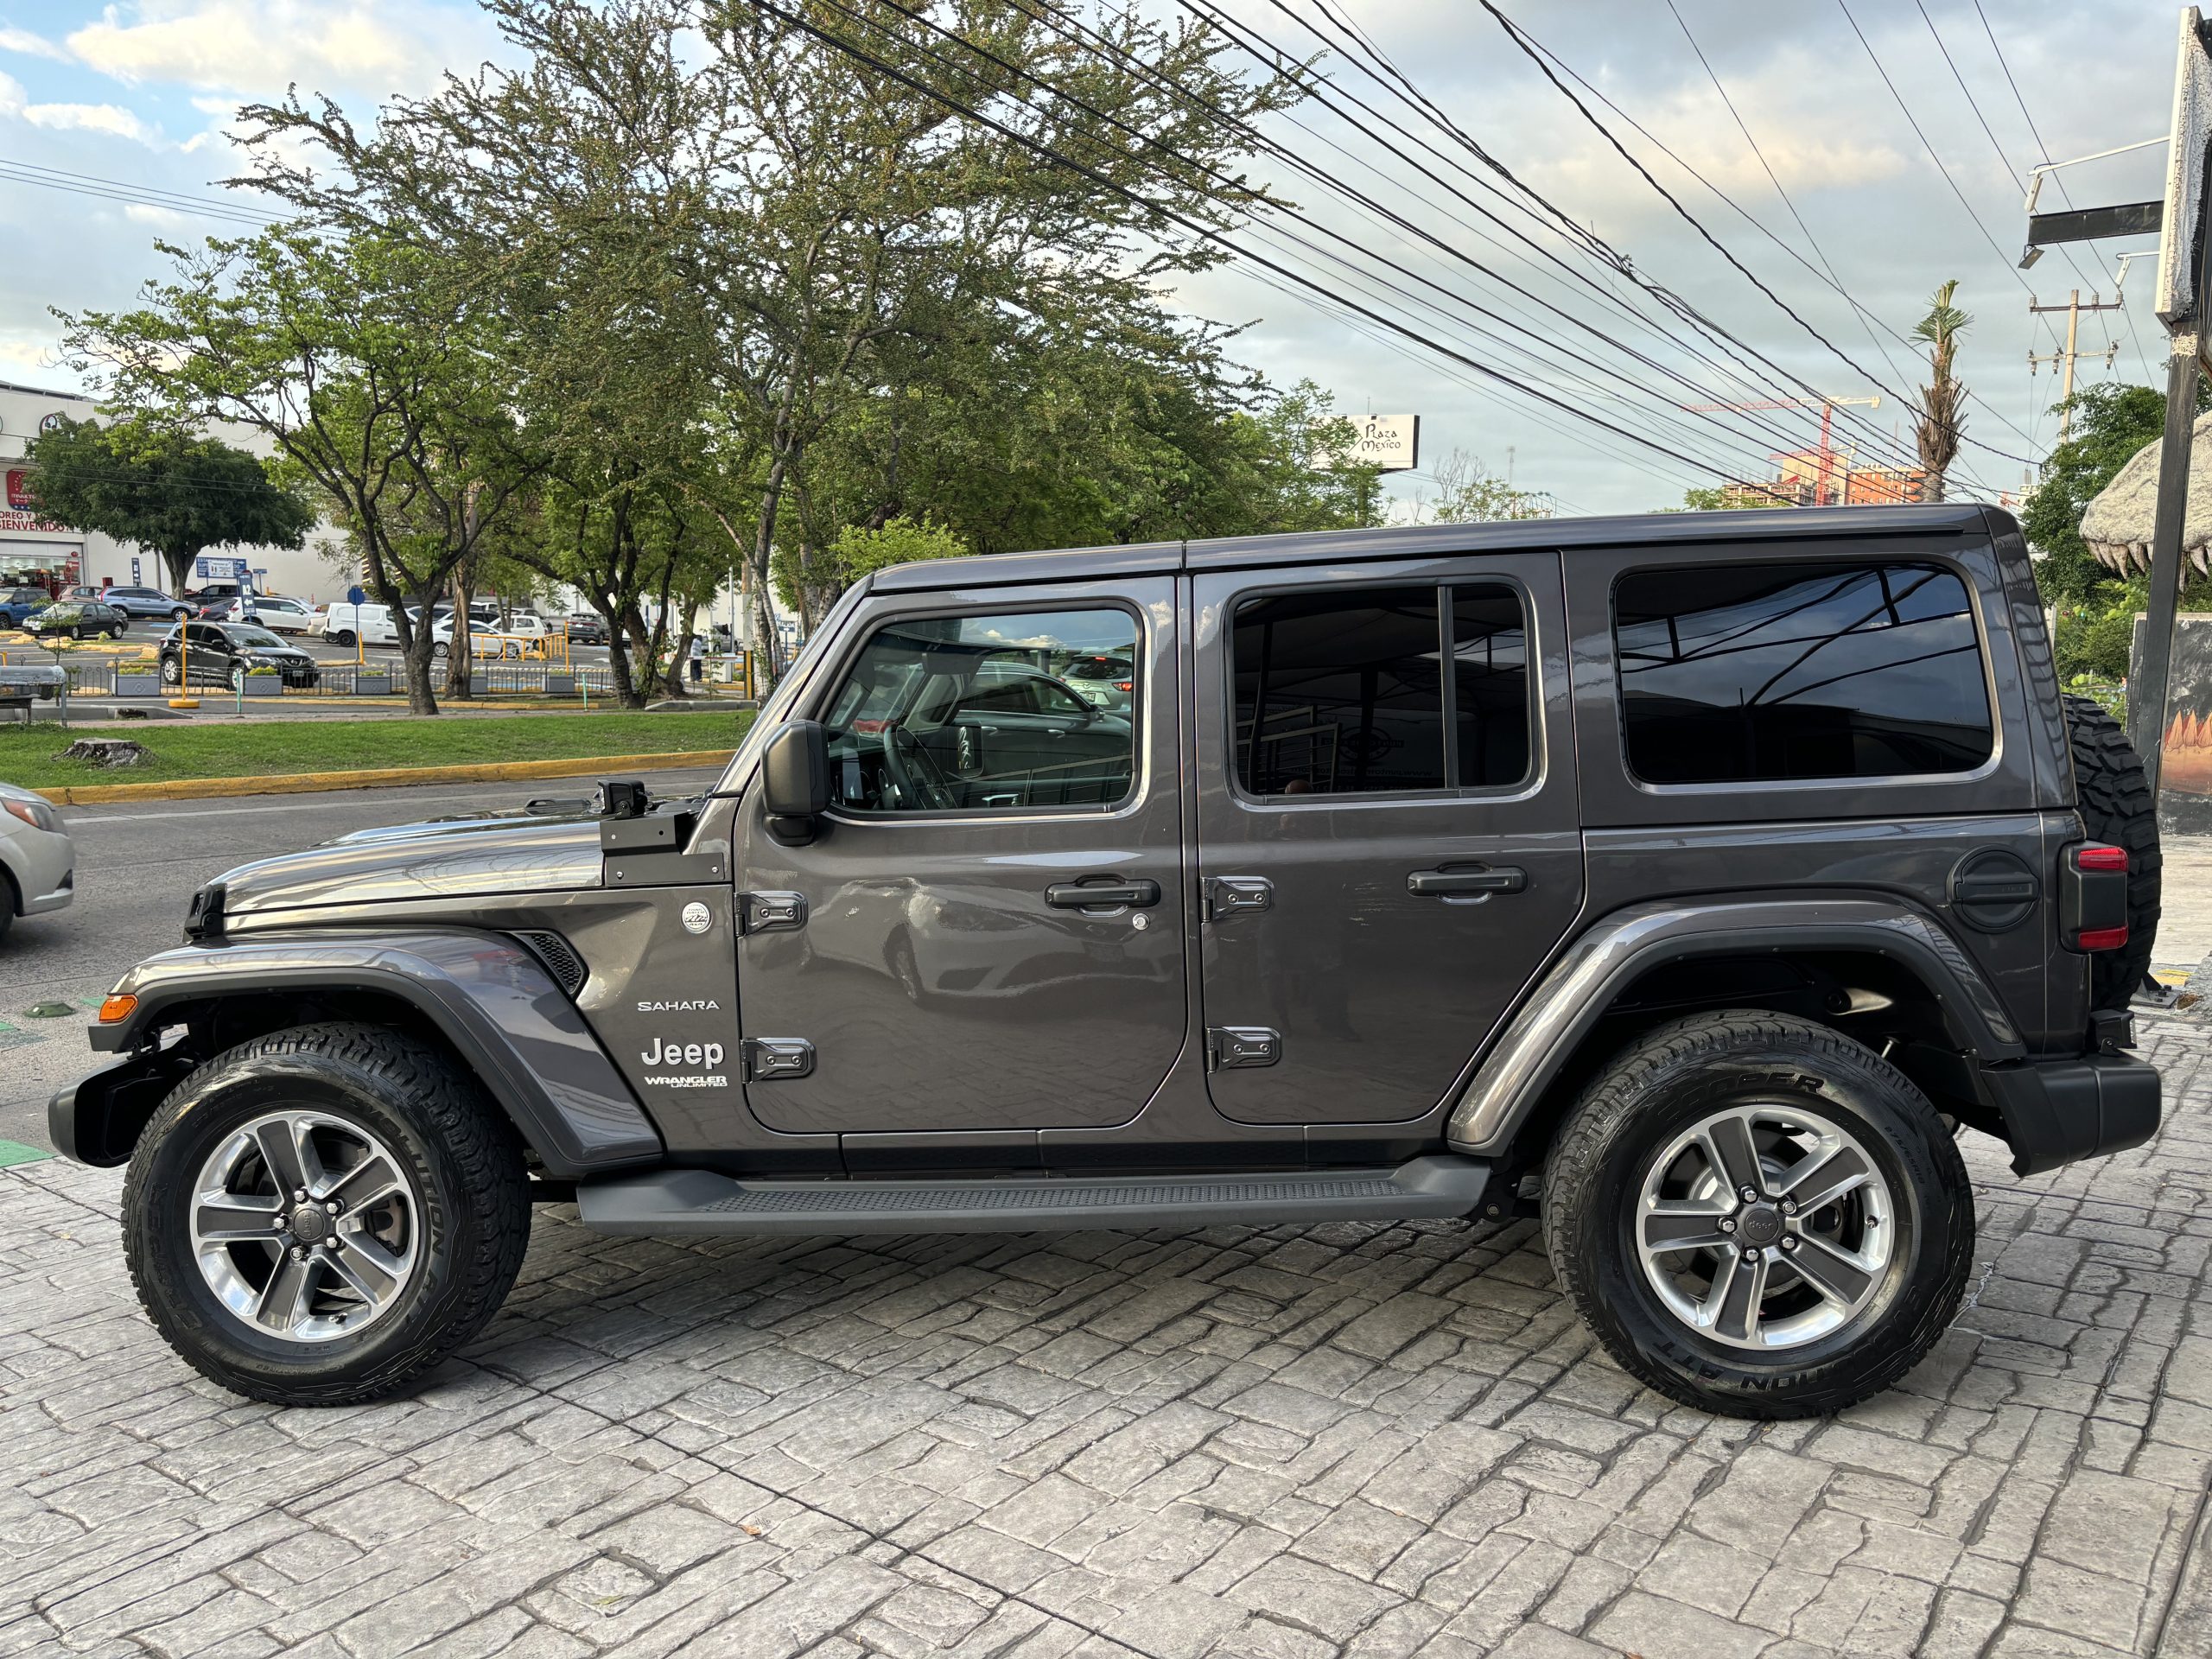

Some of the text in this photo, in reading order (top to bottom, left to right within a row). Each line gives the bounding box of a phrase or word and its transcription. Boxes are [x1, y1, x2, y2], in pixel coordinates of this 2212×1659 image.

[0, 520, 71, 532] IENVENIDO
[637, 1000, 721, 1012] SAHARA
[641, 1038, 725, 1070] Jeep
[644, 1076, 728, 1085] WRANGLER
[340, 1090, 445, 1259] EVOLUTION
